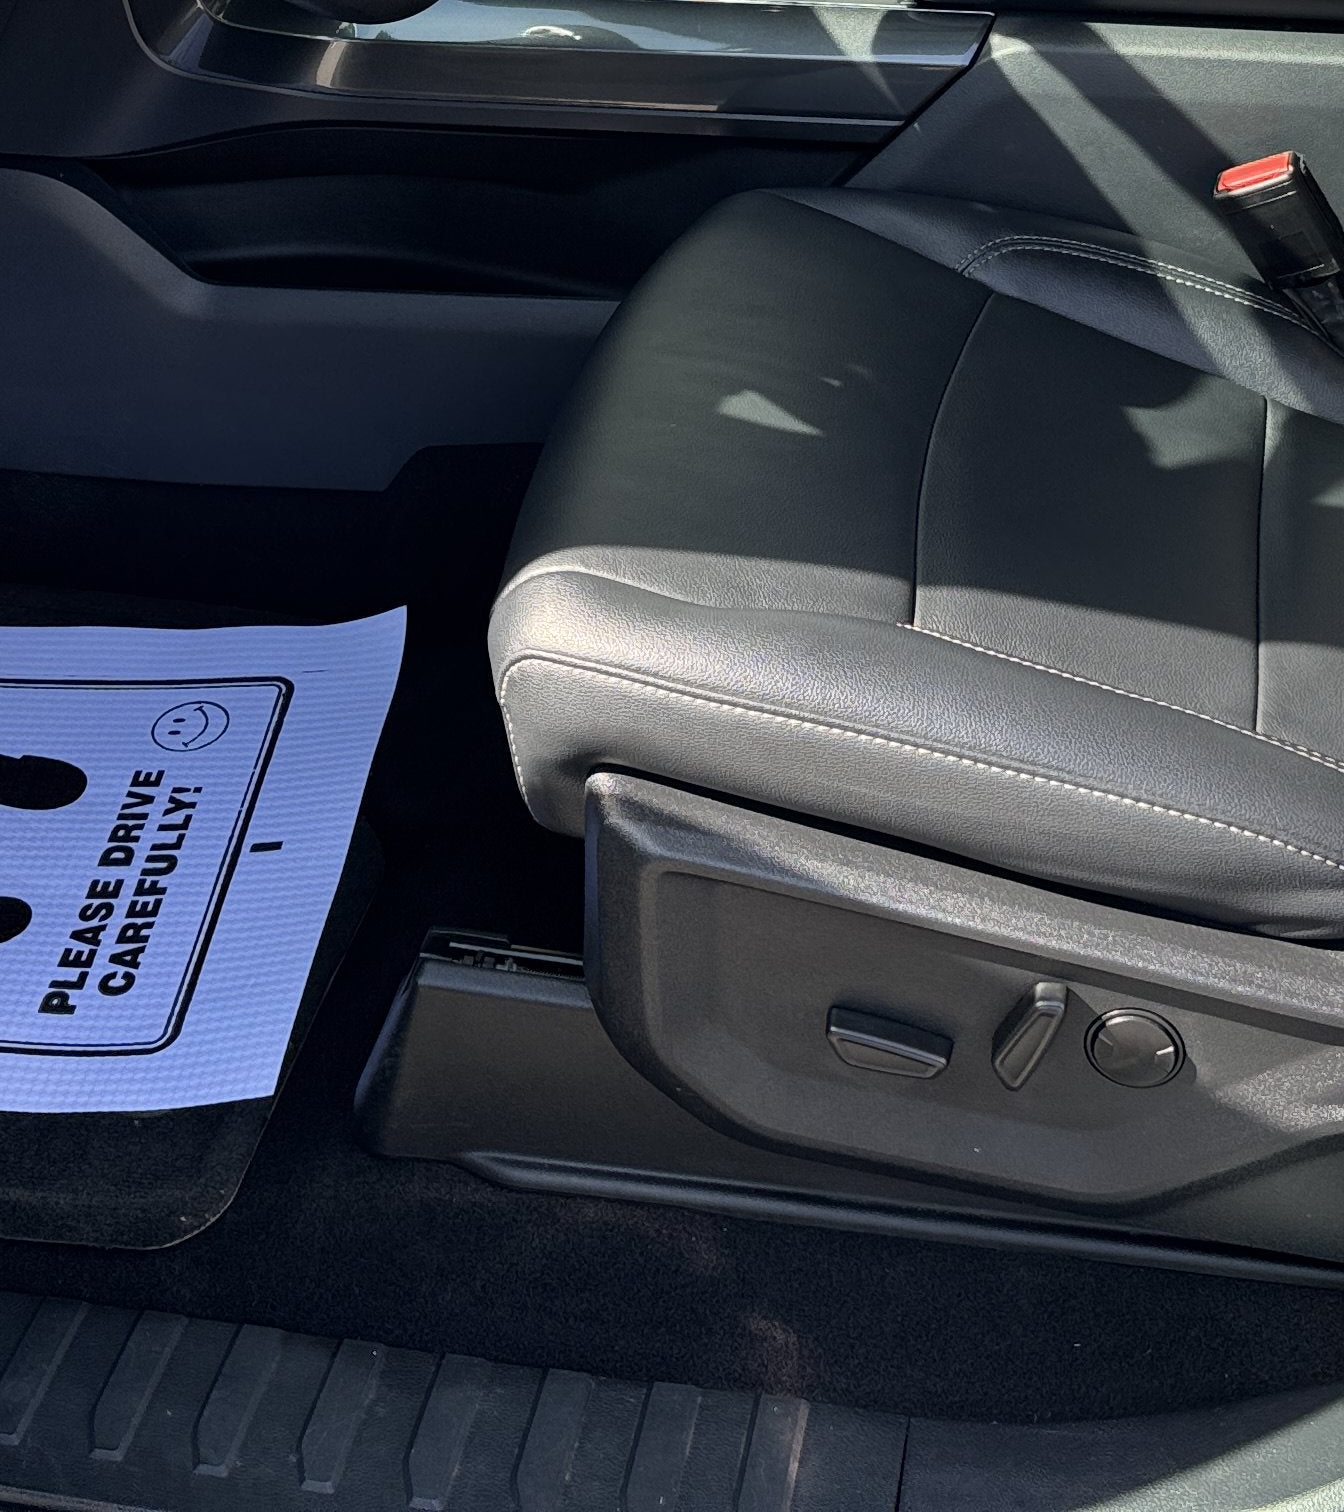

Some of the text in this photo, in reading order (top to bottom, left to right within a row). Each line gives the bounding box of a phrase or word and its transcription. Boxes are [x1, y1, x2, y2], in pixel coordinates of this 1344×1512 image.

[38, 769, 166, 1015] PLEASE DRIVE
[97, 786, 204, 997] CAREFULLY!
